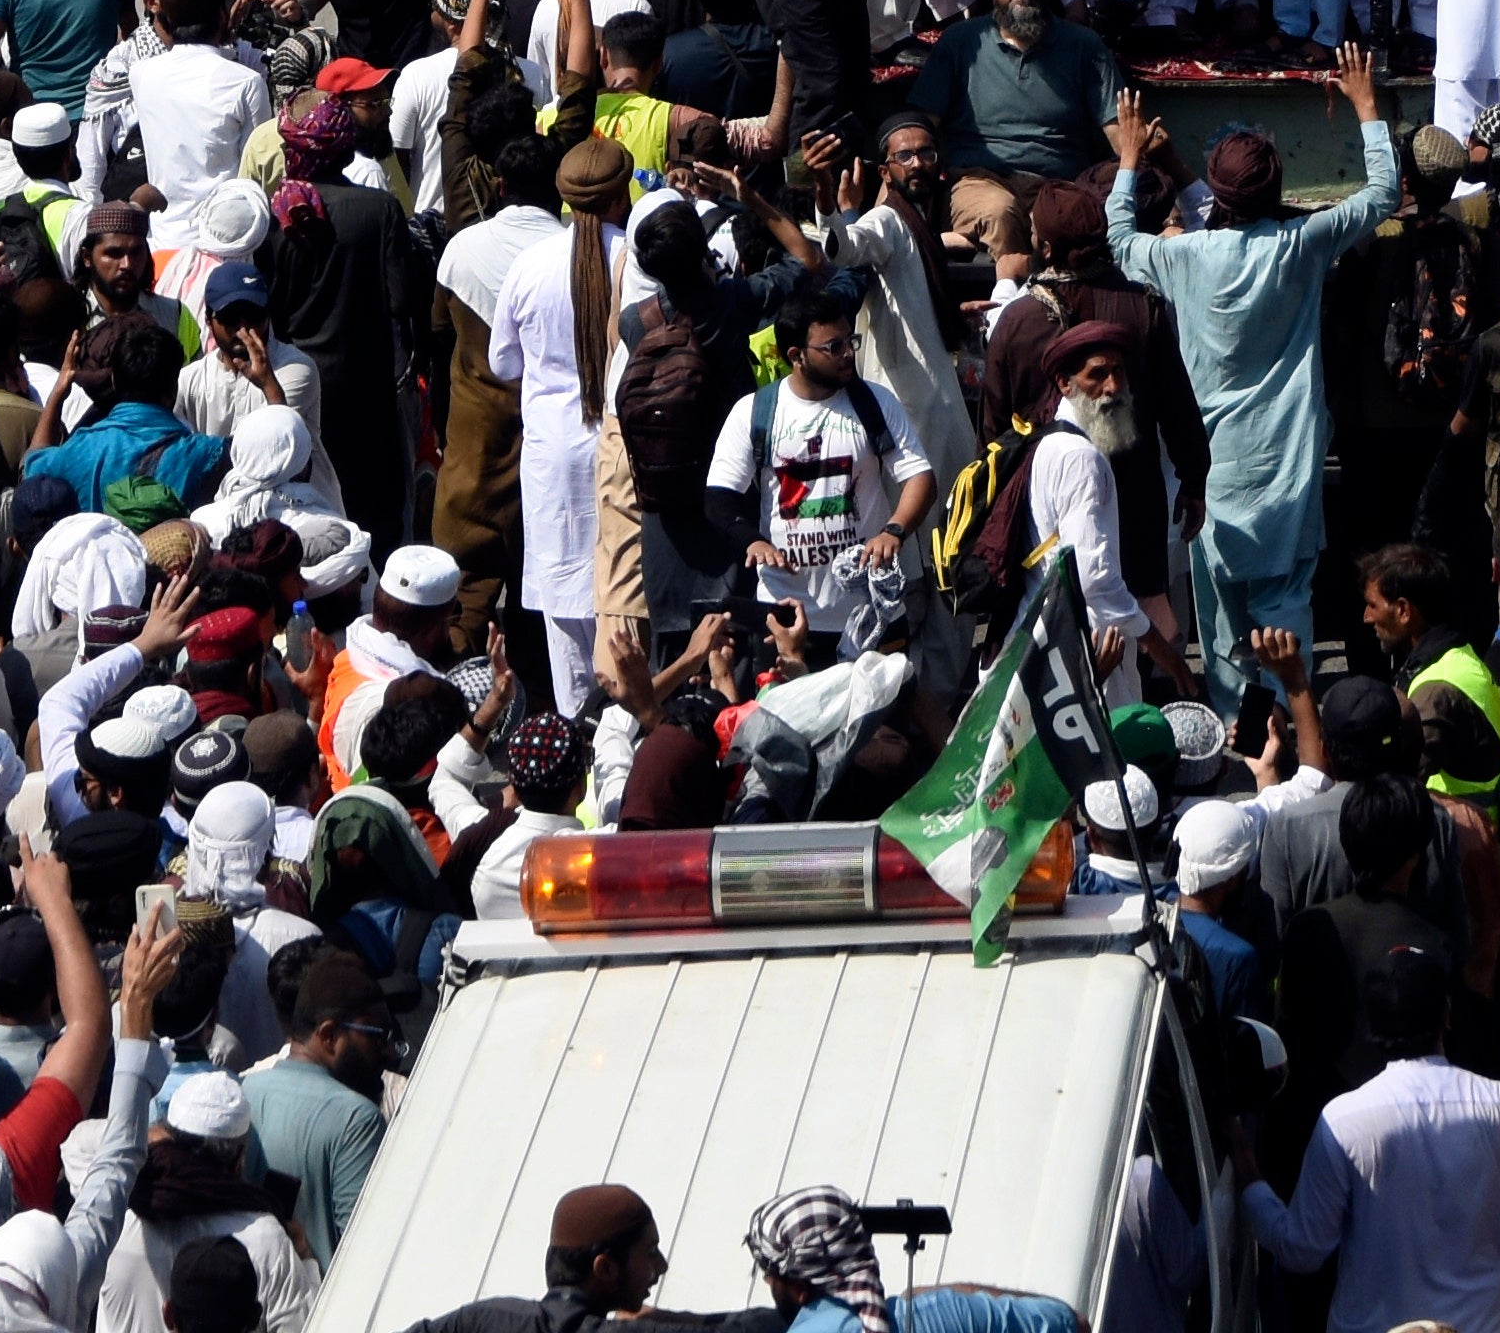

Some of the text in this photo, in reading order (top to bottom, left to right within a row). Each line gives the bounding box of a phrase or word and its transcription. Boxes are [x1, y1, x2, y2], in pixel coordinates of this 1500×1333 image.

[786, 527, 857, 547] STAND WITH
[779, 537, 866, 567] PALEST
